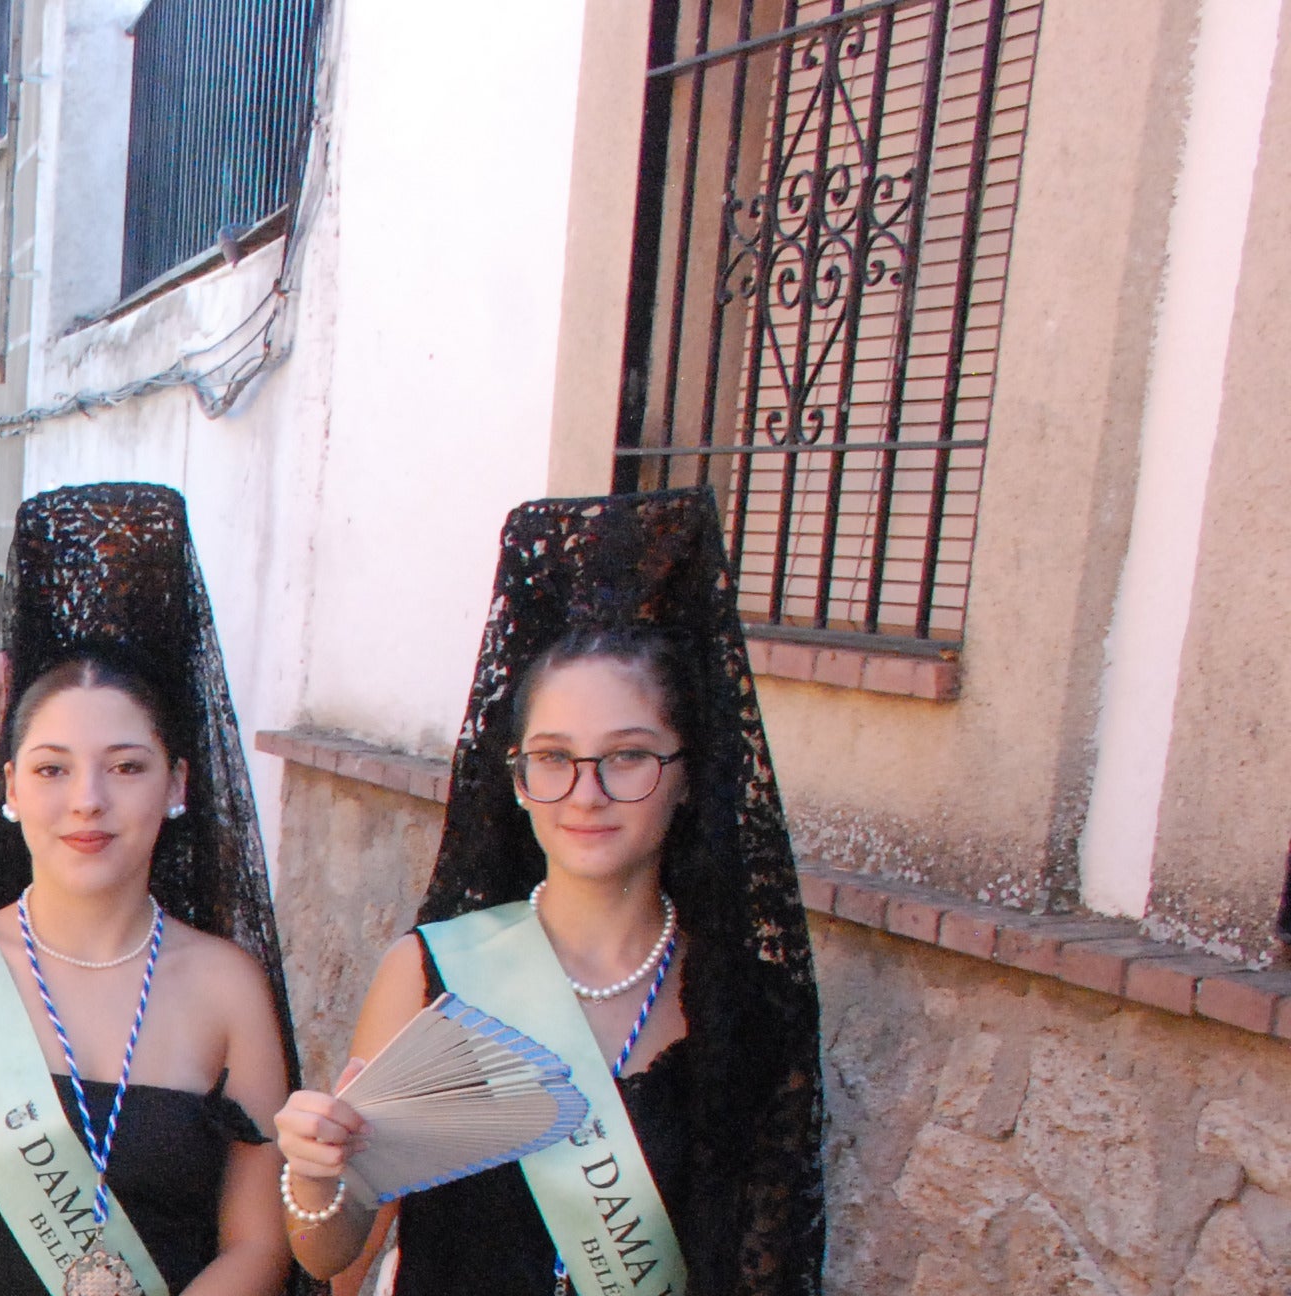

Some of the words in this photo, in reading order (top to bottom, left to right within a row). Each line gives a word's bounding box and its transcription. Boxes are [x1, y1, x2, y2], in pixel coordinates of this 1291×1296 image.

[18, 1133, 100, 1254] DAMA
[29, 1212, 75, 1276] BELÉ
[581, 1151, 659, 1288] DAMA
